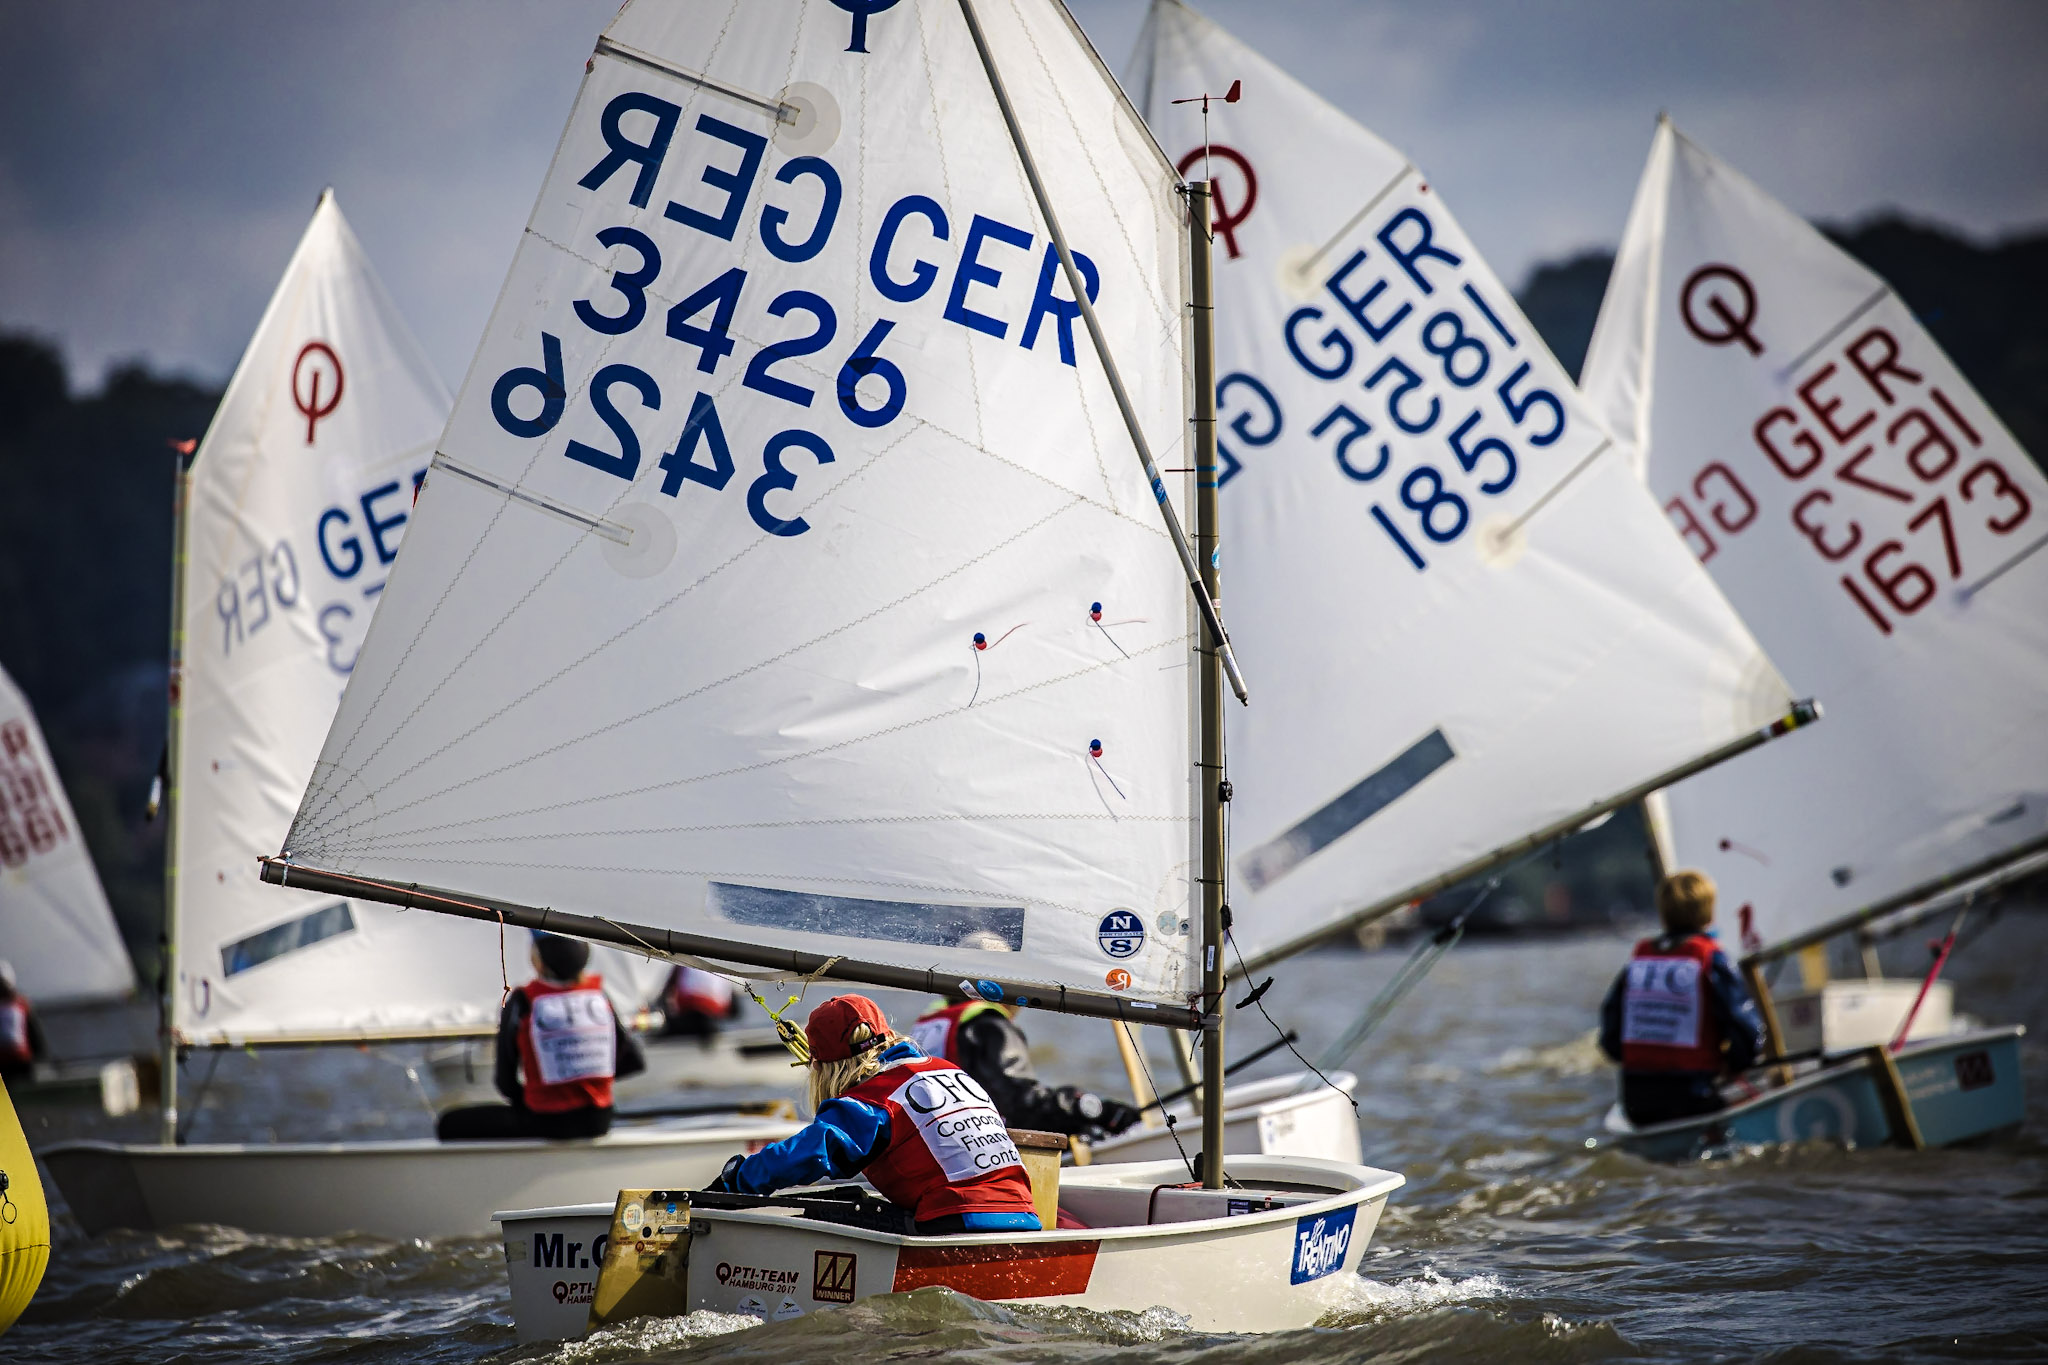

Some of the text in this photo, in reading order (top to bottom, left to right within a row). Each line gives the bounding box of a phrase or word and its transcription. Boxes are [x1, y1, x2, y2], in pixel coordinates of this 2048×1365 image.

[572, 226, 907, 428] 3426
[869, 194, 1100, 367] GER
[1284, 207, 1462, 381] GER
[1369, 360, 1566, 571] 1855
[1752, 326, 1923, 481] GER
[317, 466, 429, 580] GE
[1841, 459, 2032, 636] 1673
[961, 1132, 1009, 1152] Finan
[974, 1149, 1018, 1170] Cont
[729, 1278, 796, 1295] HAMBURG 2017
[816, 1289, 851, 1301] WINNER
